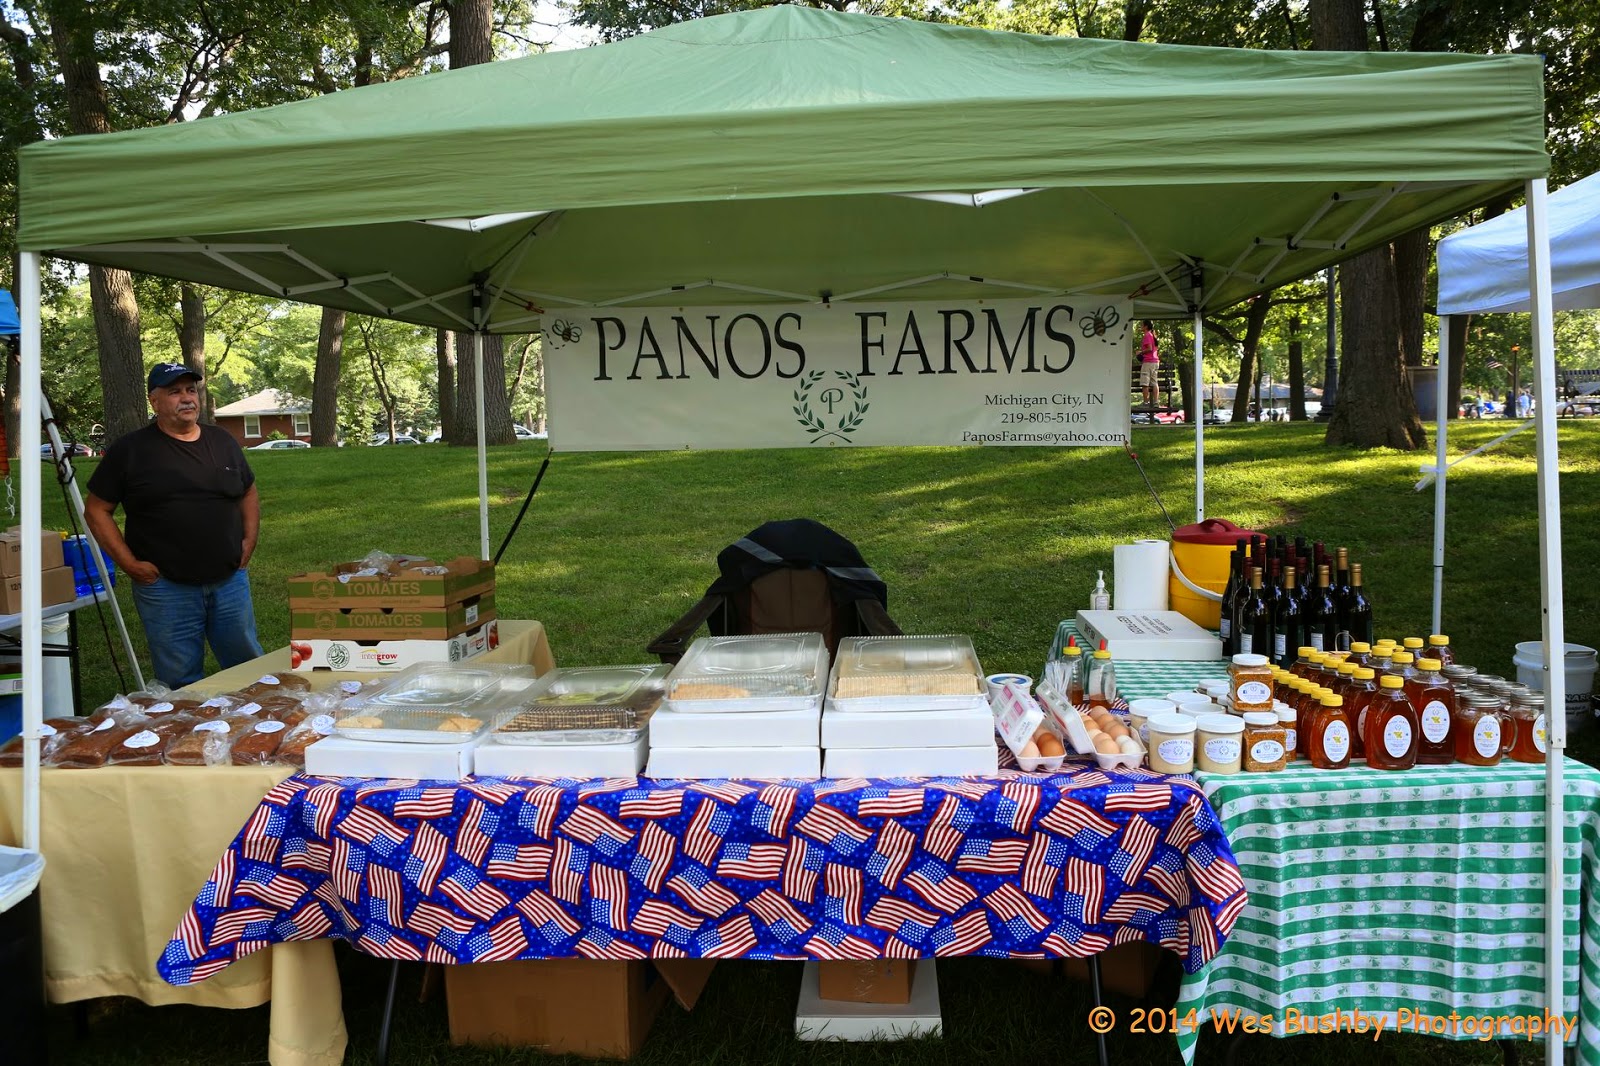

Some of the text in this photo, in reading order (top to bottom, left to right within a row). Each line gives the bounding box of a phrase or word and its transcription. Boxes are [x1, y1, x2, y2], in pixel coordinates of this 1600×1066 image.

[589, 304, 1077, 381] PANOS FARMS
[820, 387, 844, 415] P
[985, 393, 1104, 408] Michigan City, IN
[1001, 412, 1087, 424] 219-805-5105
[962, 431, 1126, 444] PanosFarms@yahoo.com
[345, 582, 421, 595] TOMATES
[346, 614, 423, 627] TOMATOES
[361, 653, 398, 661] intergrow
